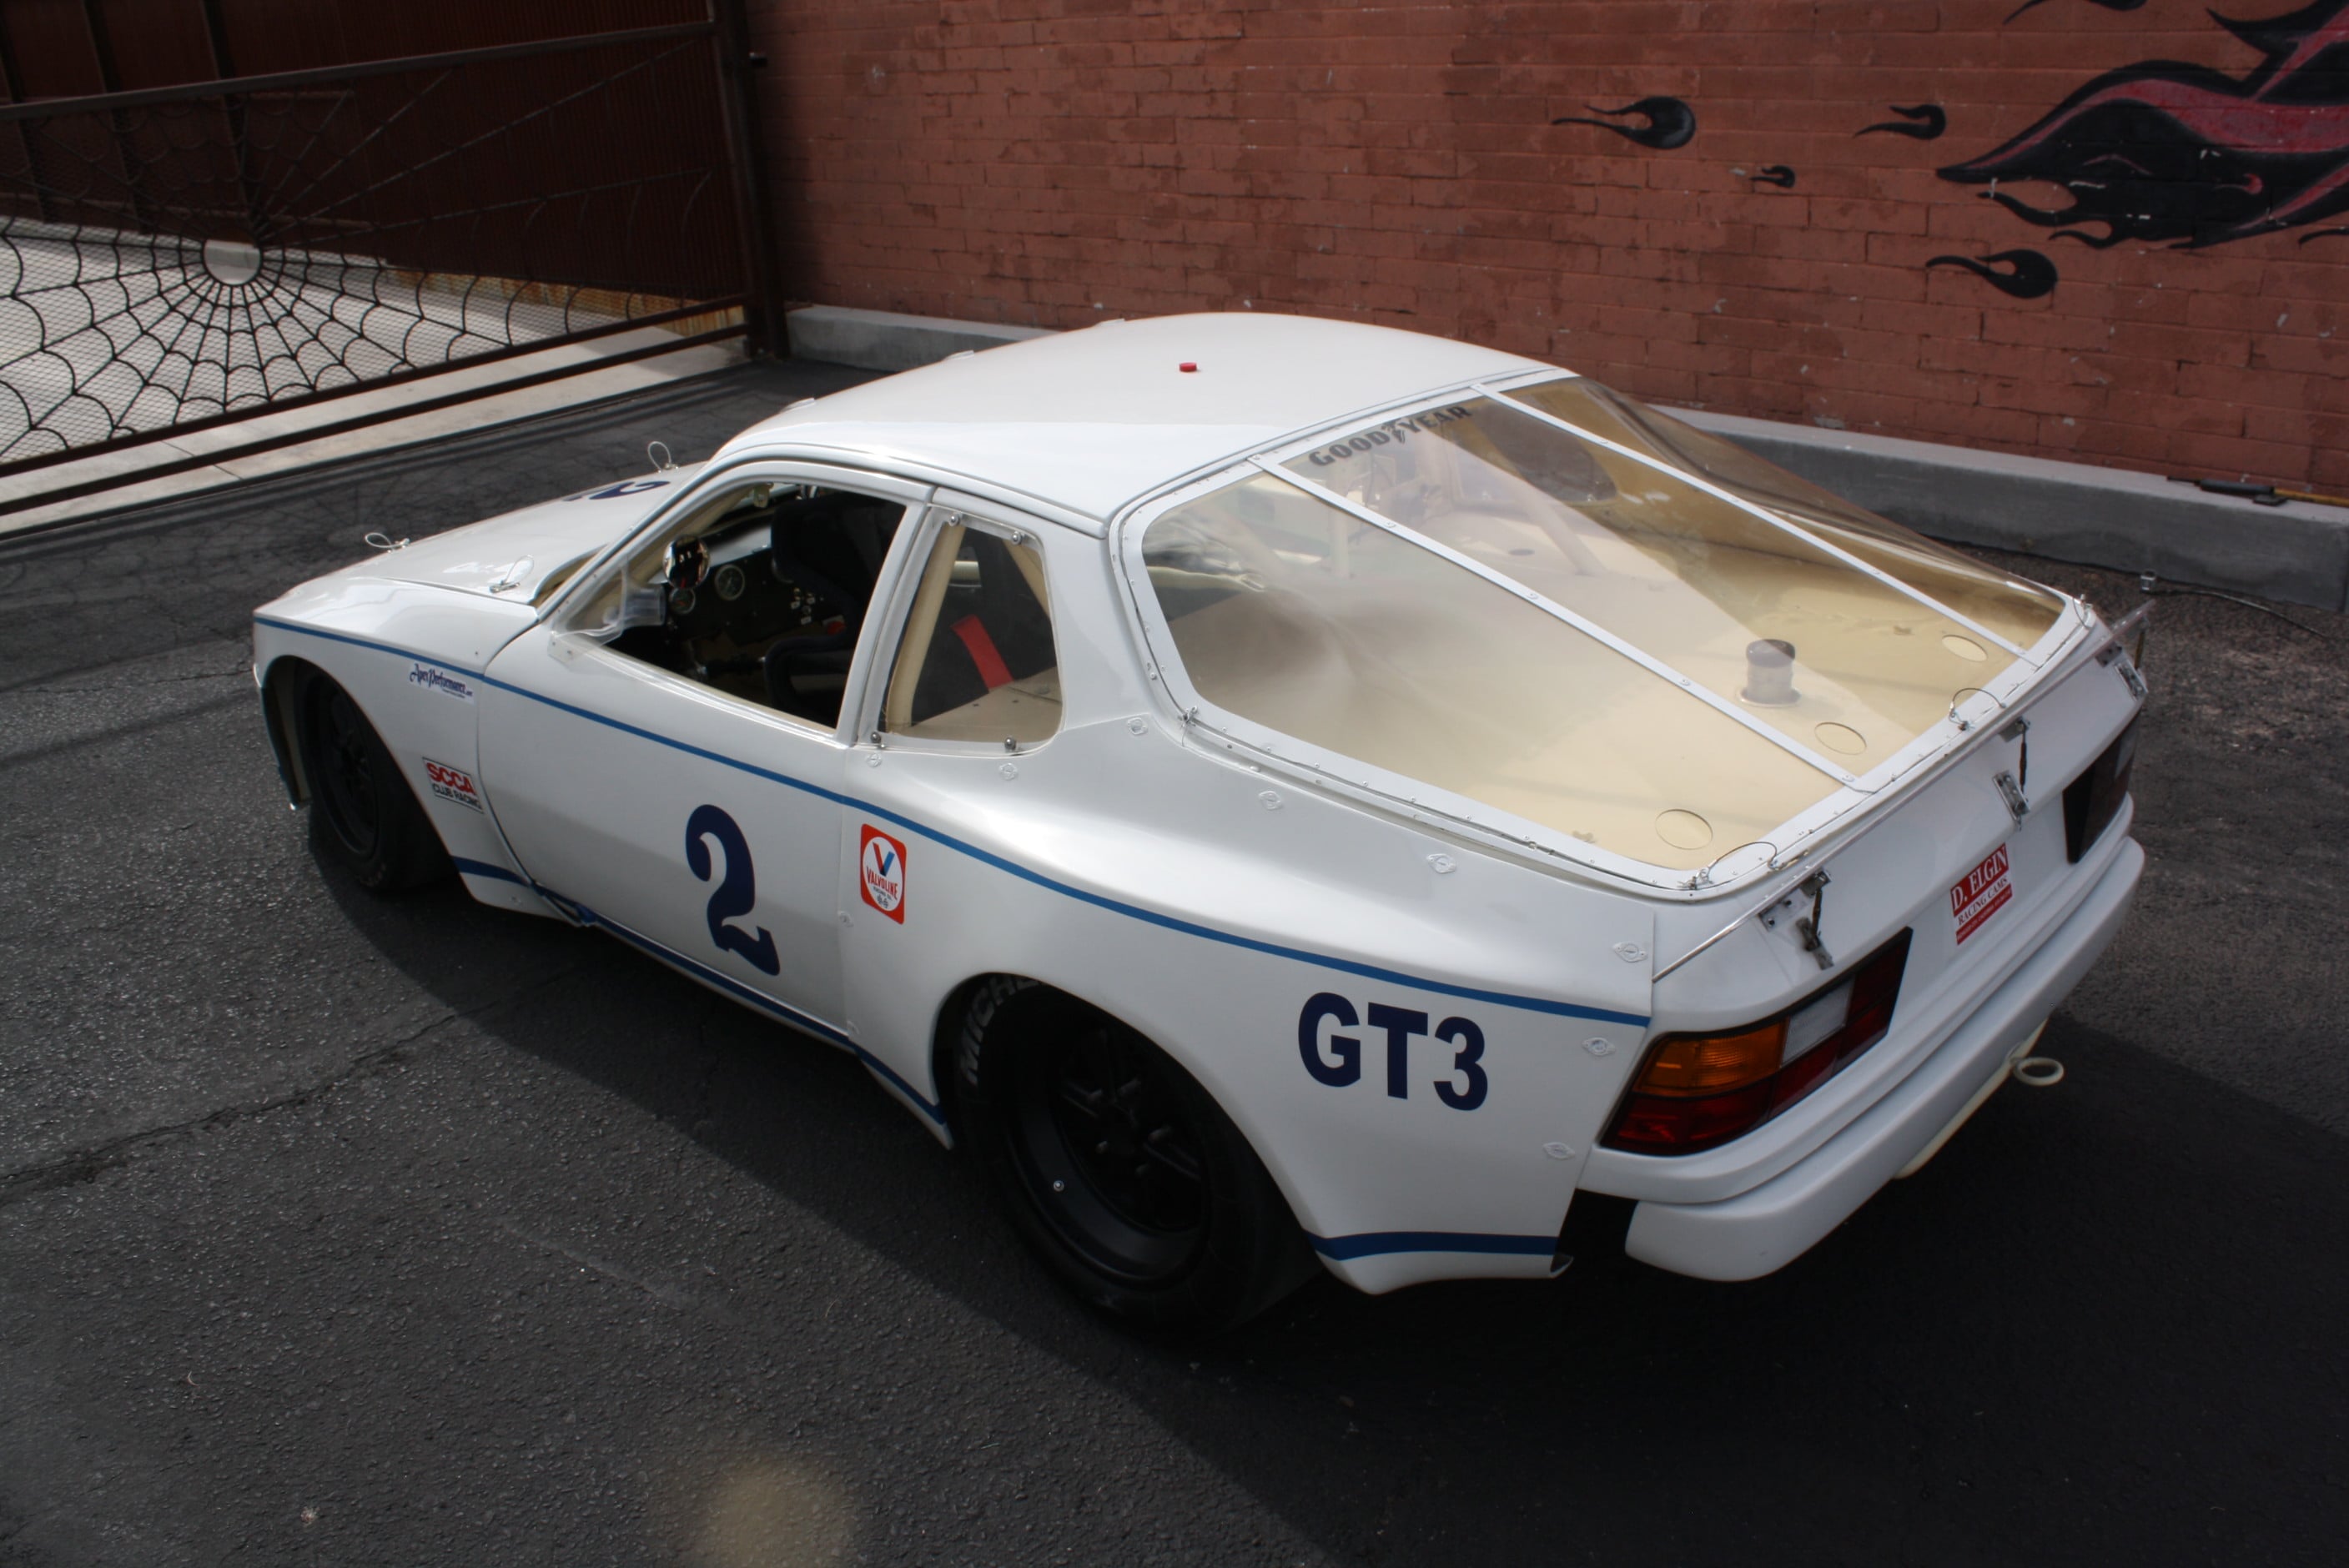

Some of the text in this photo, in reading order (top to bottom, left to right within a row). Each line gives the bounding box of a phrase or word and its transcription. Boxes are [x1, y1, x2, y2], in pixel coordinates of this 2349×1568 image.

[426, 762, 475, 795] SCCA
[432, 783, 484, 810] CLUB RACING
[686, 804, 780, 976] 2
[866, 865, 898, 901] VALVOLINE
[1952, 846, 2008, 911] D. ELGIN
[1957, 897, 1986, 926] RACING
[1988, 875, 2008, 899] CAMS
[1298, 992, 1488, 1111] GT3
